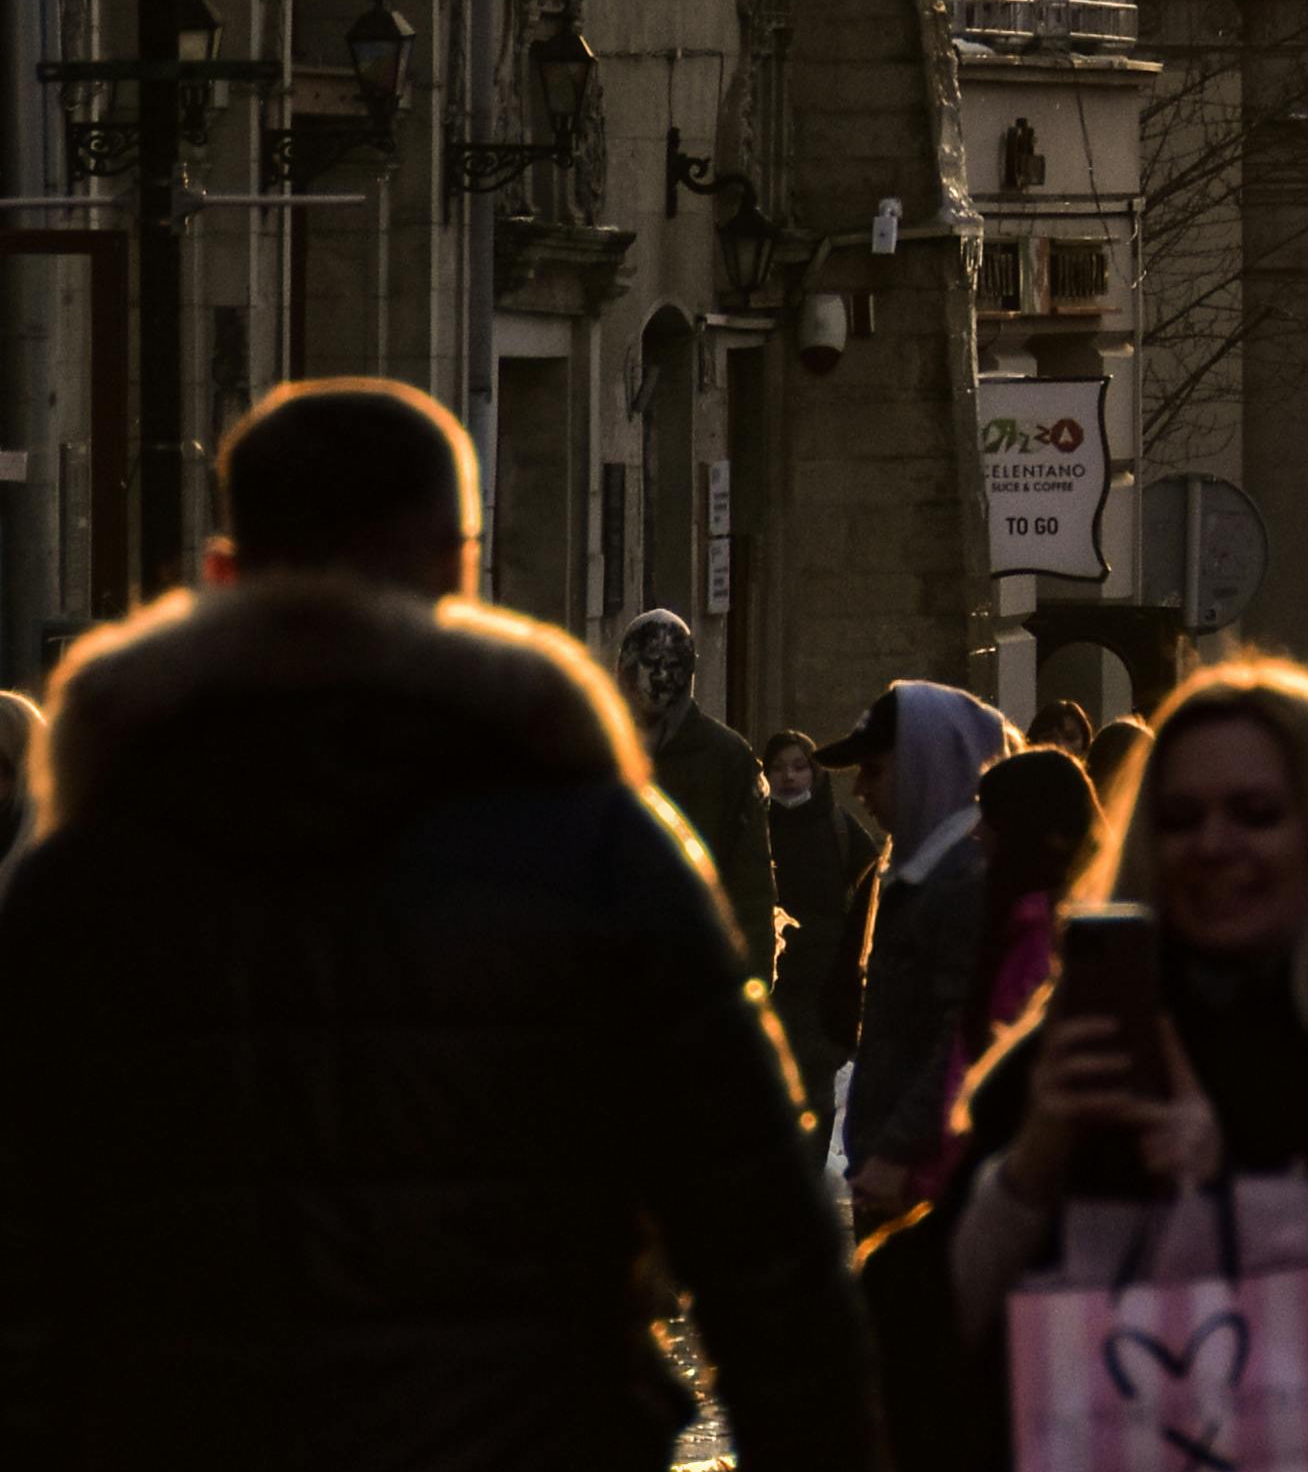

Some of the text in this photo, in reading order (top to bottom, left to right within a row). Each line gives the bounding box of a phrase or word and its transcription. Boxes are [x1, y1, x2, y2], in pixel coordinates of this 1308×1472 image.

[985, 464, 1085, 478] ELENTANO
[1033, 482, 1073, 492] COFFEE
[1005, 517, 1059, 535] TO GO
